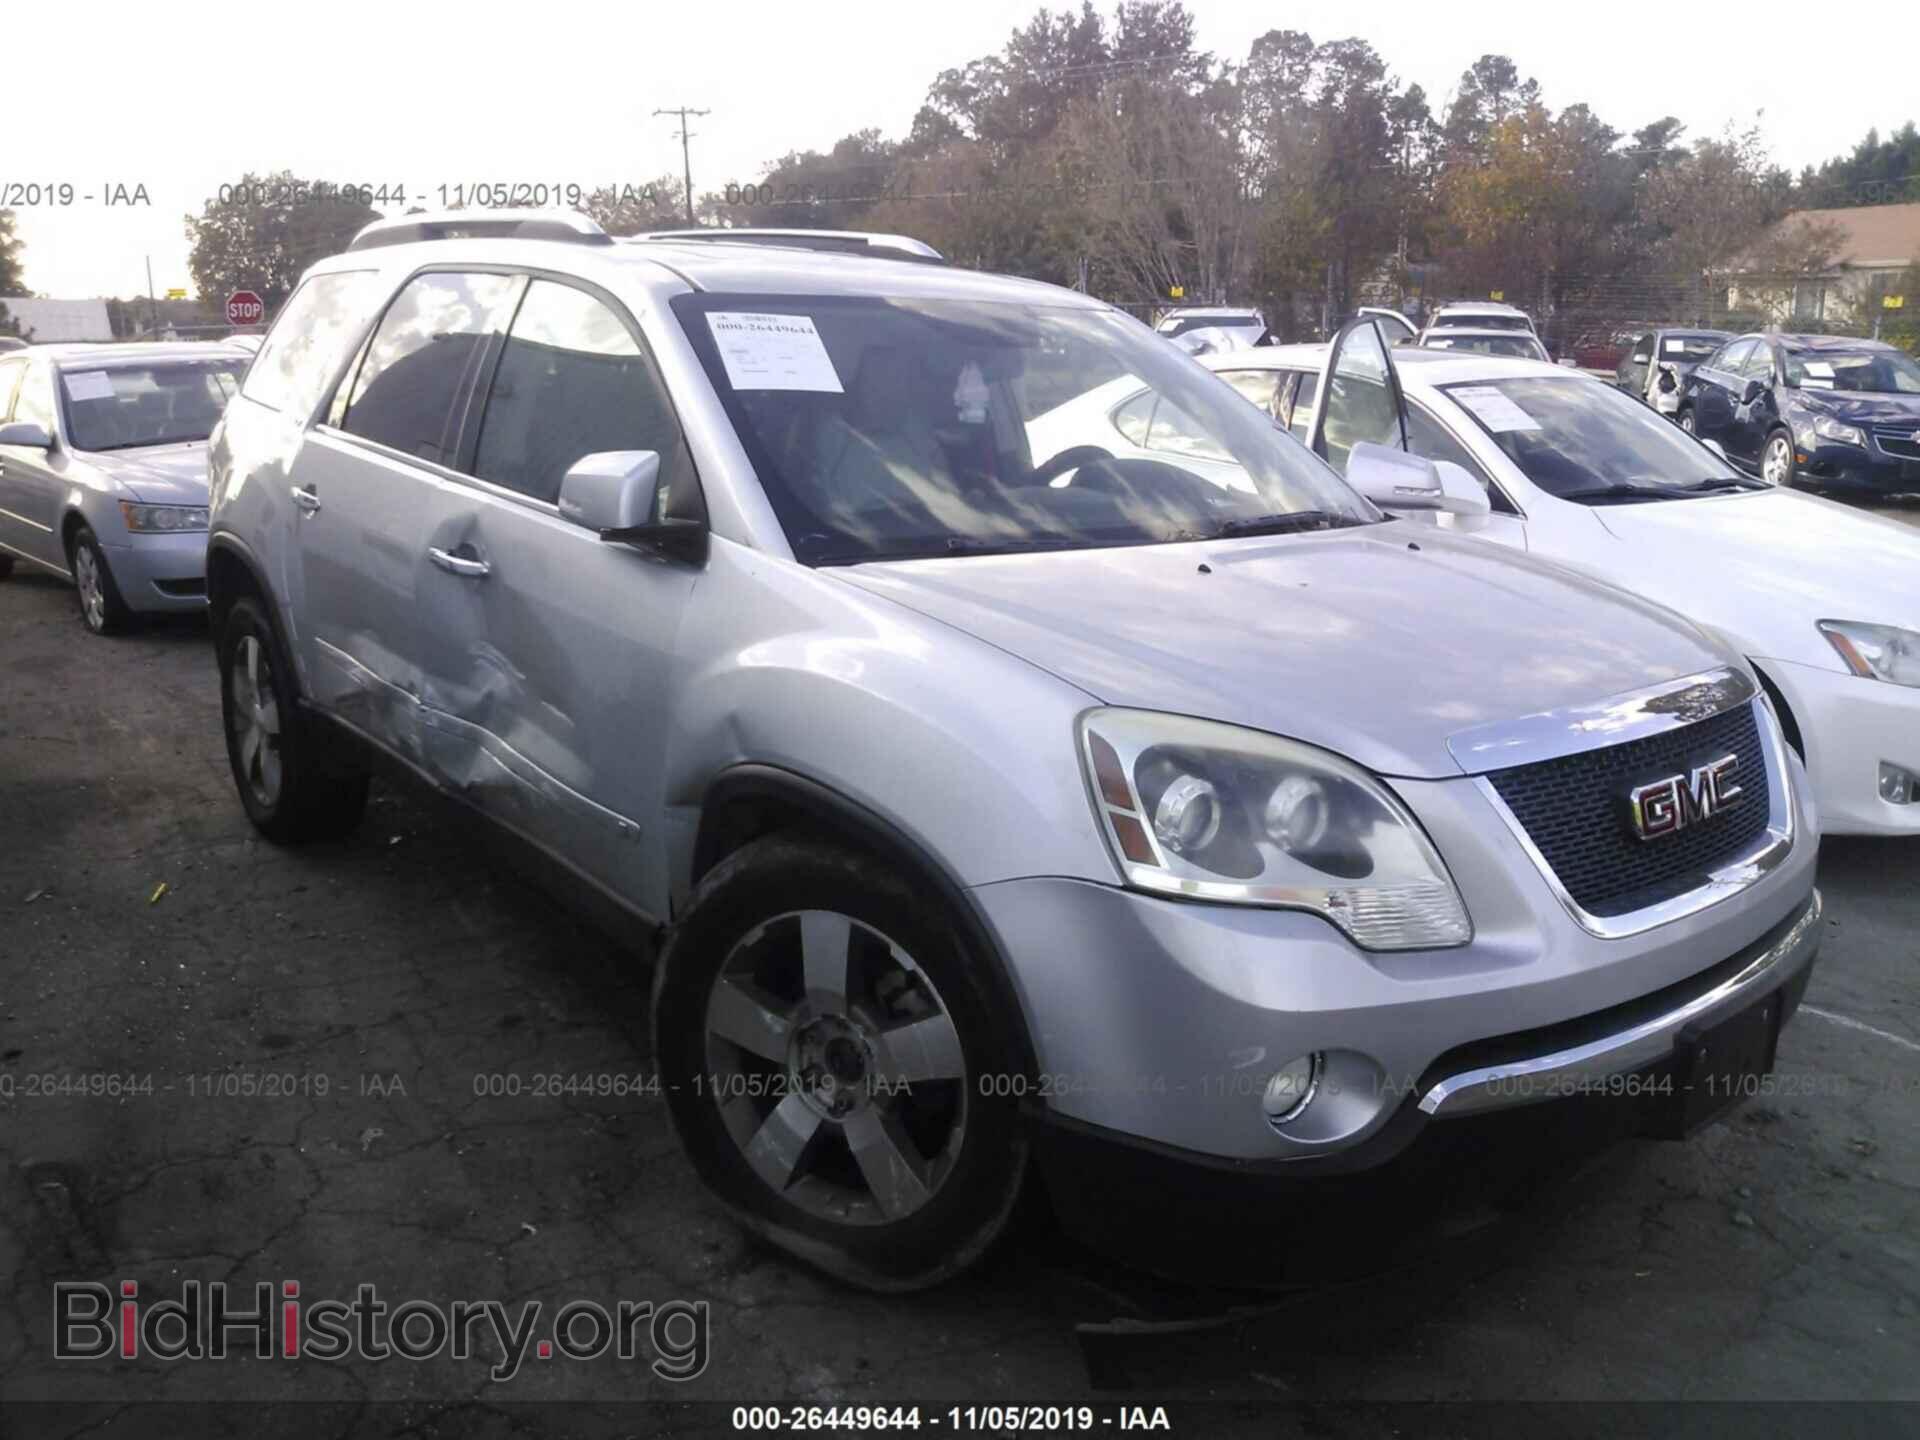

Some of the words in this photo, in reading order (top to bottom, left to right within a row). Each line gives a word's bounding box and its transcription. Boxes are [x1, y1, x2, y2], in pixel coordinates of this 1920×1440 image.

[229, 302, 261, 318] STOP
[716, 322, 815, 335] 000-26449644
[1630, 753, 1743, 841] GMC
